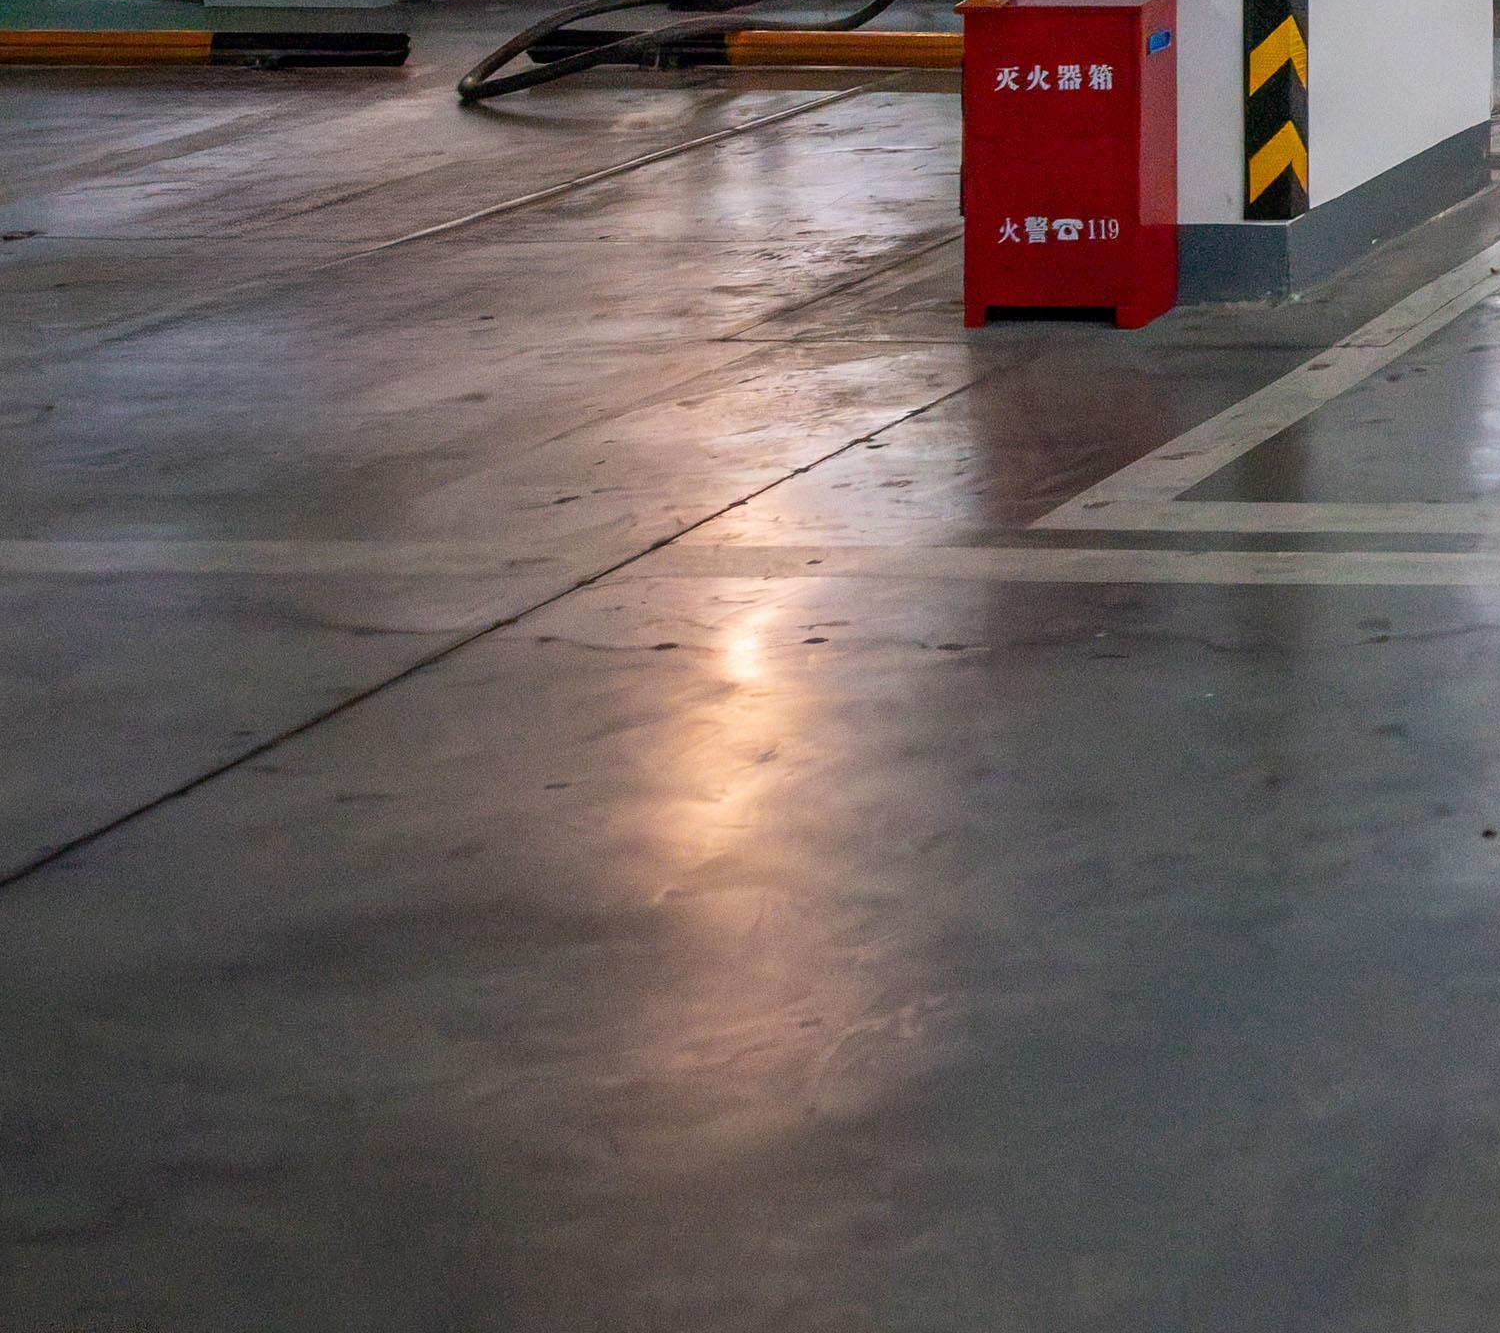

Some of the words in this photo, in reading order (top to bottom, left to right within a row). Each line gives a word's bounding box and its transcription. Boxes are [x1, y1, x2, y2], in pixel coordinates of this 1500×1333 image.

[993, 64, 1114, 92] 灭火器箱
[997, 215, 1049, 244] 火警
[1087, 218, 1120, 241] 119
